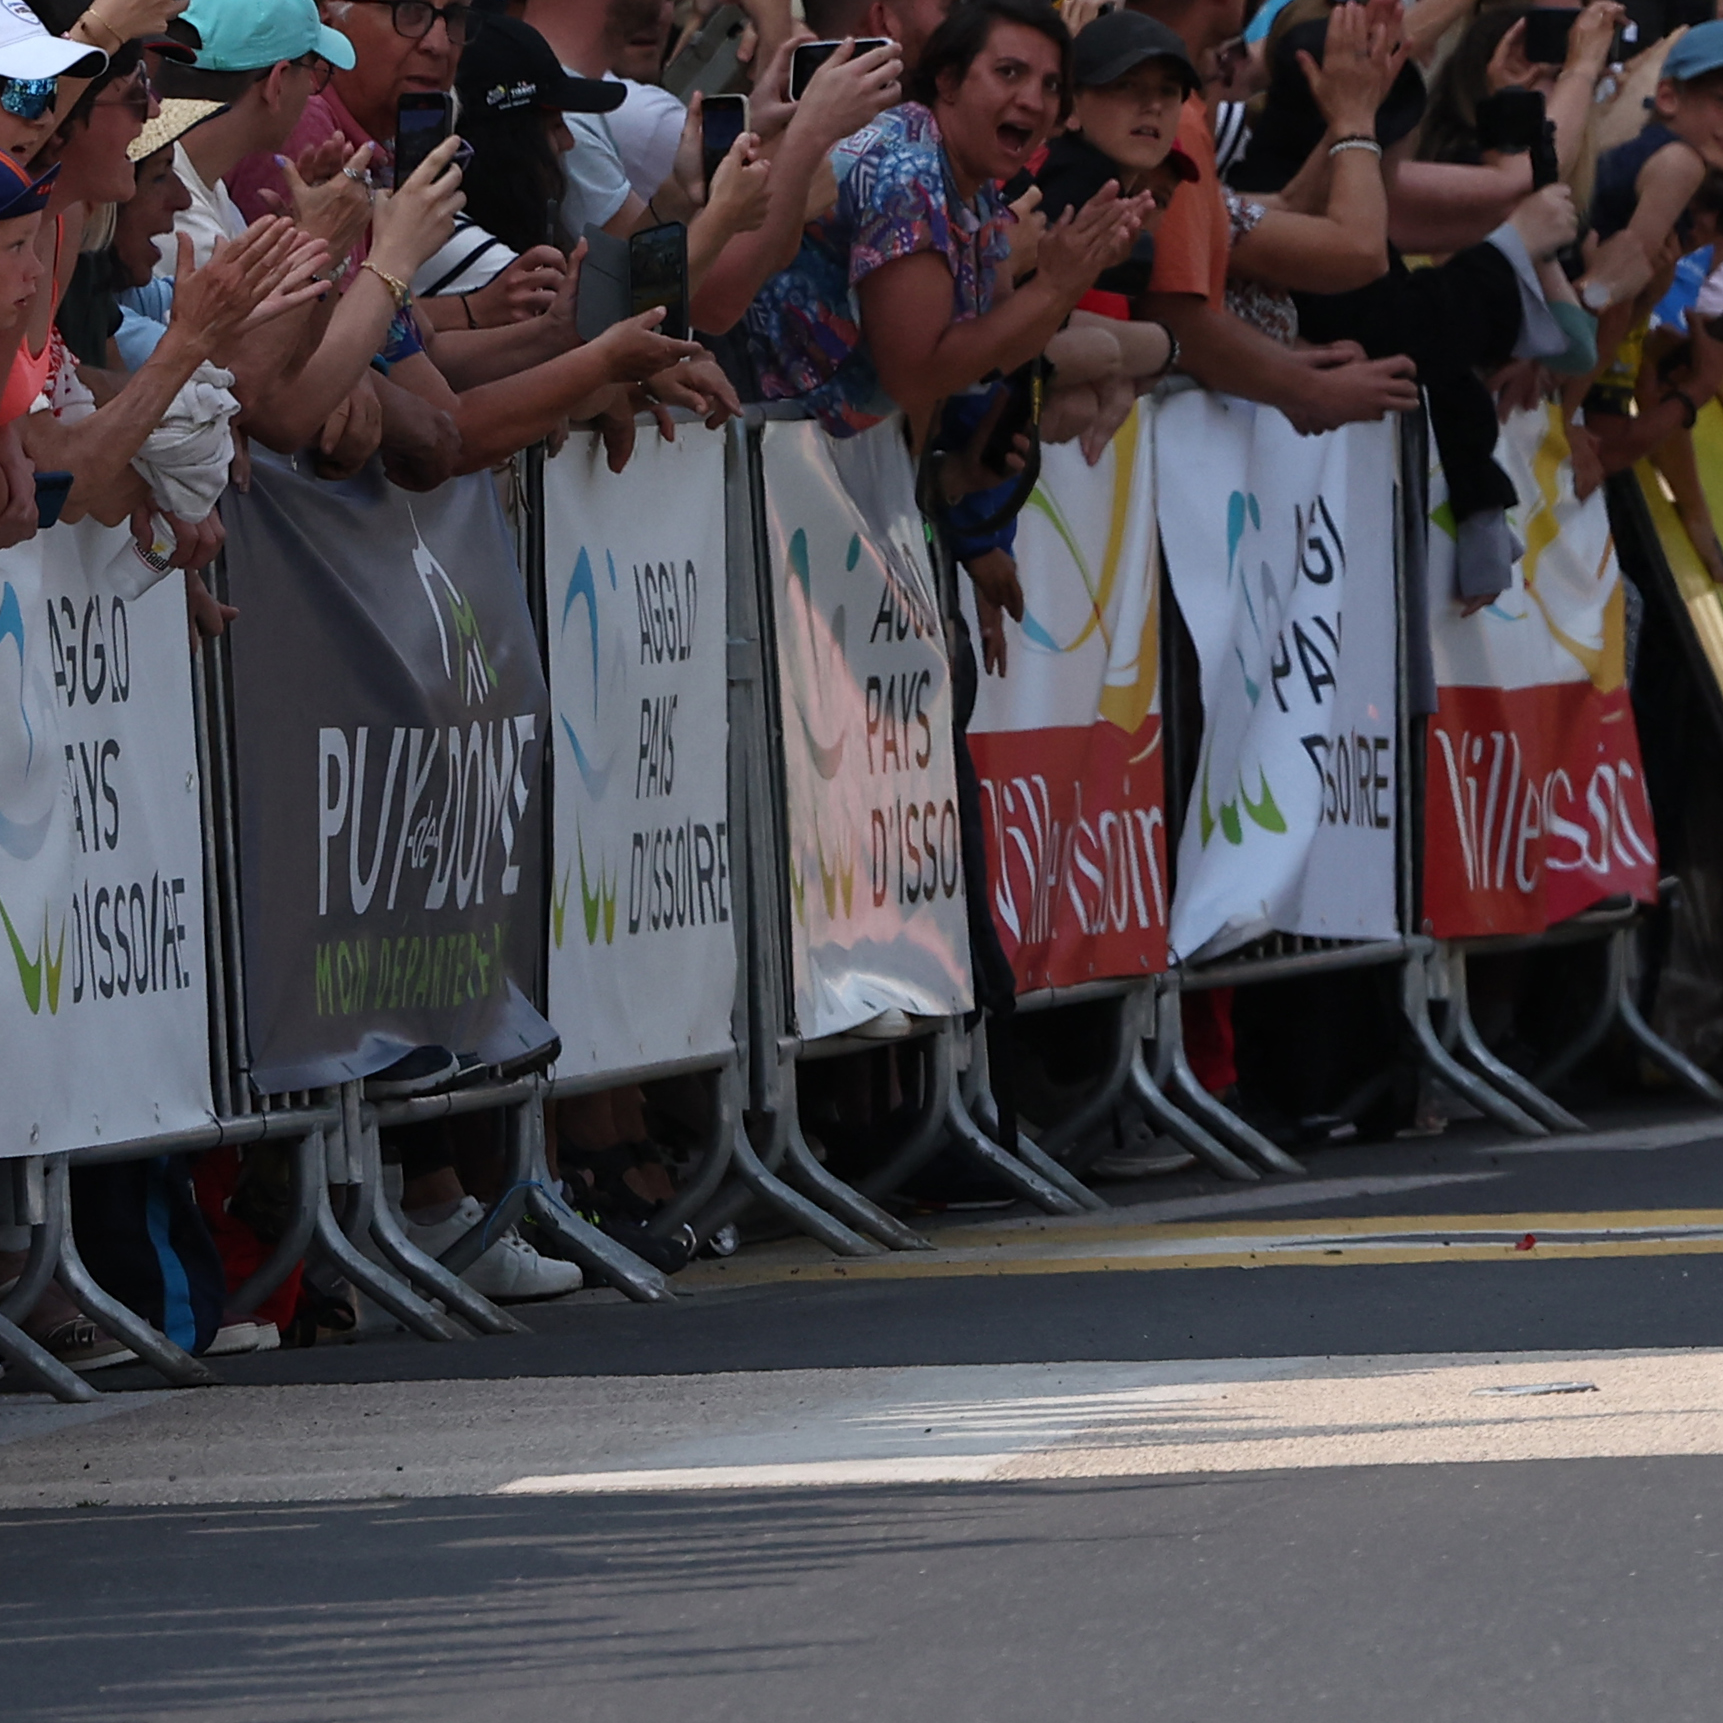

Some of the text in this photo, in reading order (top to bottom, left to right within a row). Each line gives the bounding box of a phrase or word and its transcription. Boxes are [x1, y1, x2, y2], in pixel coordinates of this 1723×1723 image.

[634, 558, 698, 666] AGGLO
[635, 693, 679, 800] PAYS
[865, 669, 932, 775] PAYS
[871, 796, 966, 908] D'ISSO
[315, 938, 370, 1017] MON
